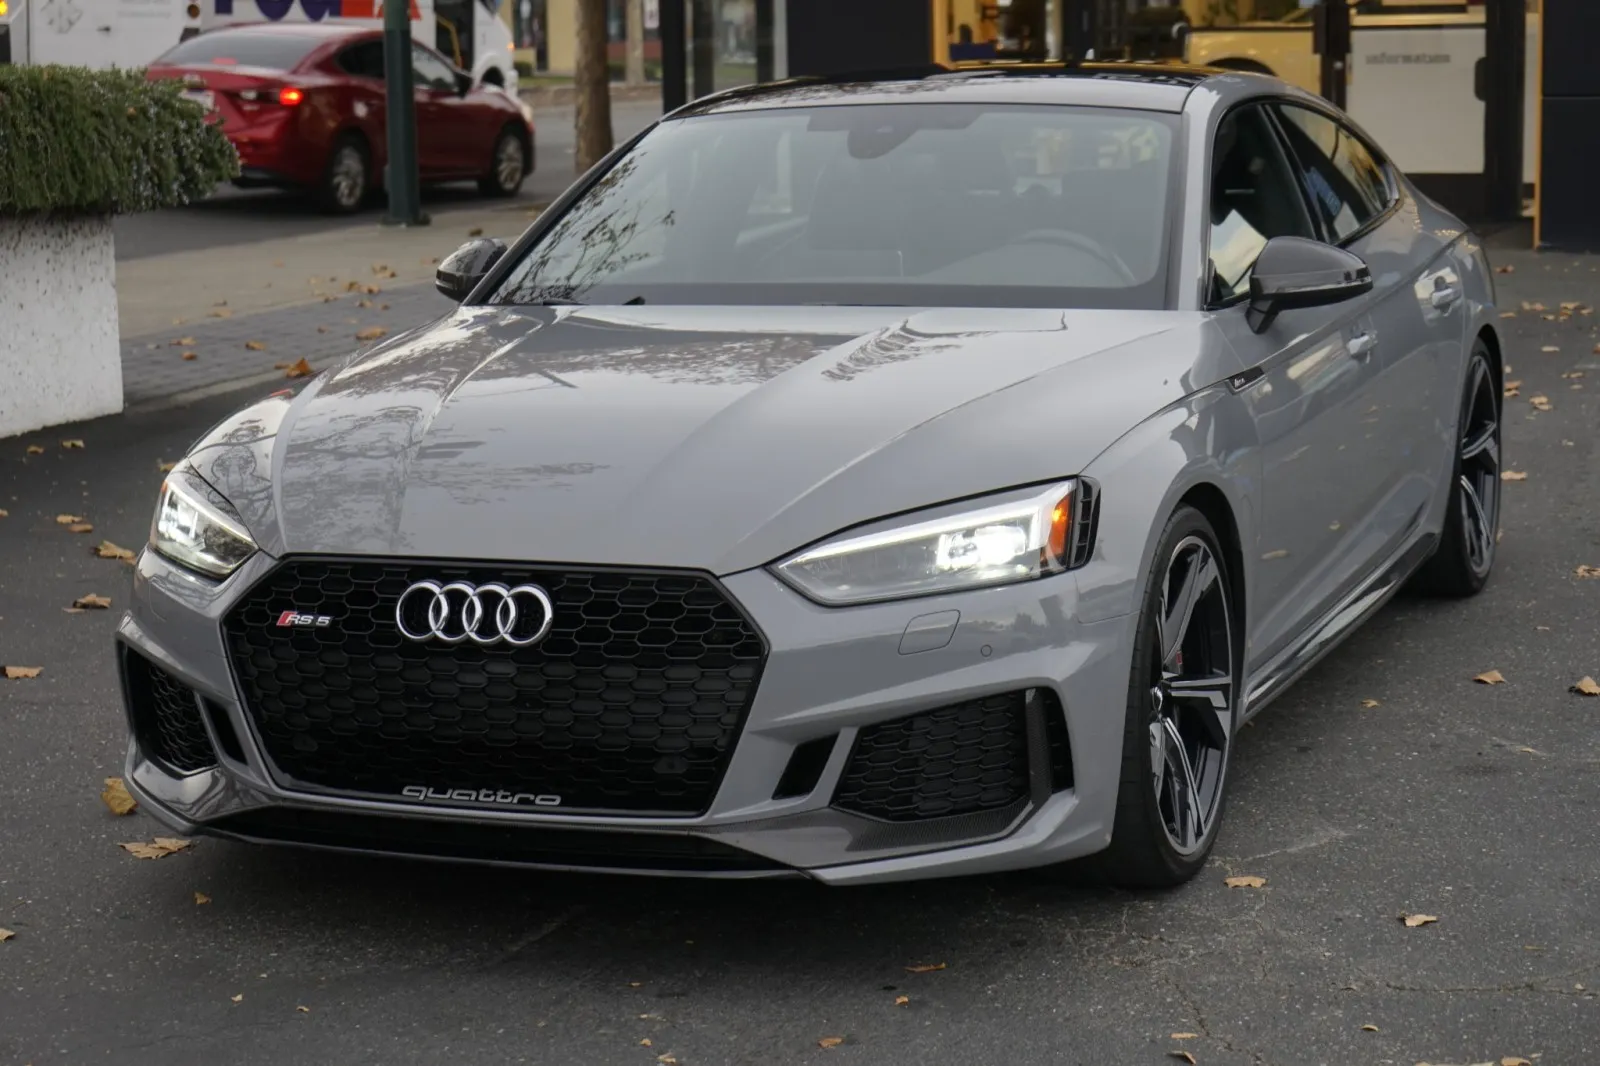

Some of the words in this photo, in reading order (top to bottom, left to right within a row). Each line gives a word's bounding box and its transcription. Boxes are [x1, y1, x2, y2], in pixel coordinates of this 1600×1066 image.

[285, 614, 314, 625] RS
[316, 616, 331, 626] 5
[402, 785, 562, 806] quattro
